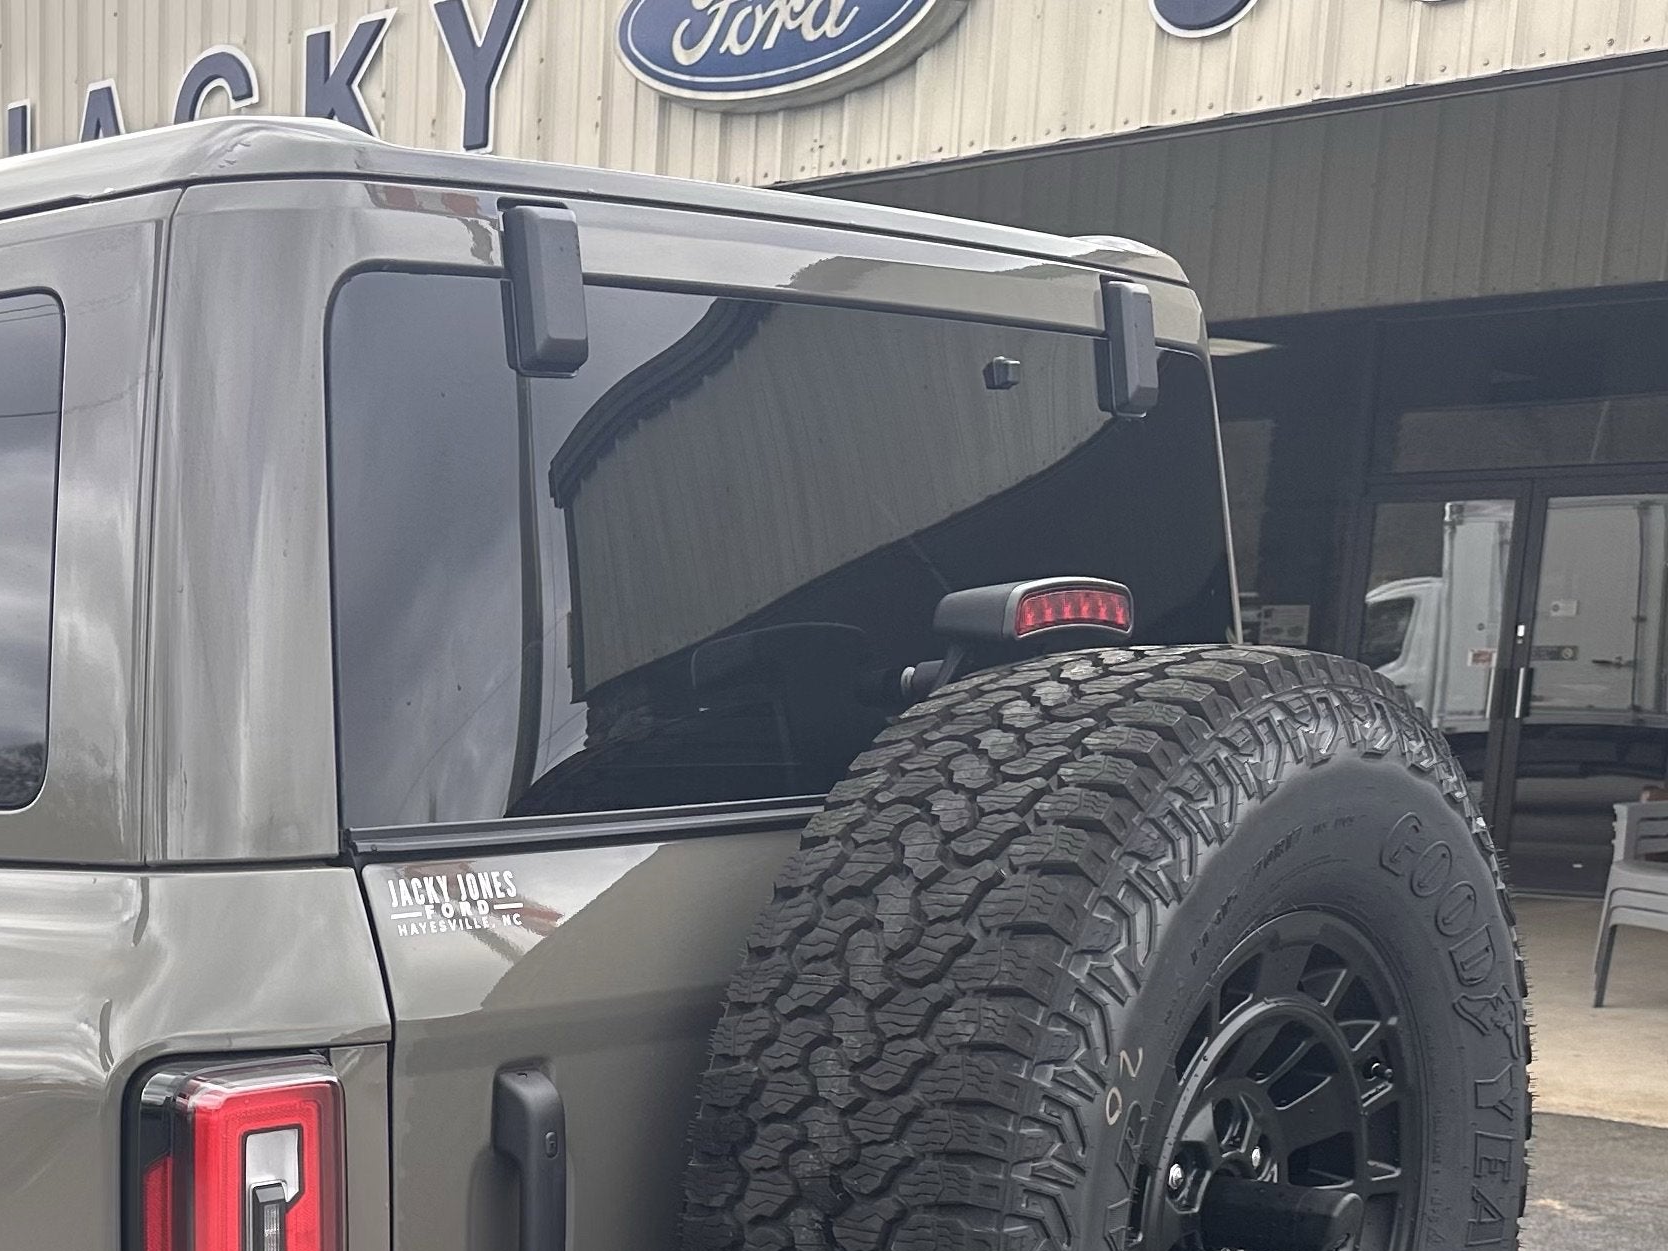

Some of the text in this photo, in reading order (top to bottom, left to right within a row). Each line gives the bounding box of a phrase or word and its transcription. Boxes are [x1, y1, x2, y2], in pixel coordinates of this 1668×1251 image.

[387, 870, 518, 908] JACKY JONES
[423, 900, 490, 920] FORD
[397, 913, 523, 937] HAYESVILLE, NC
